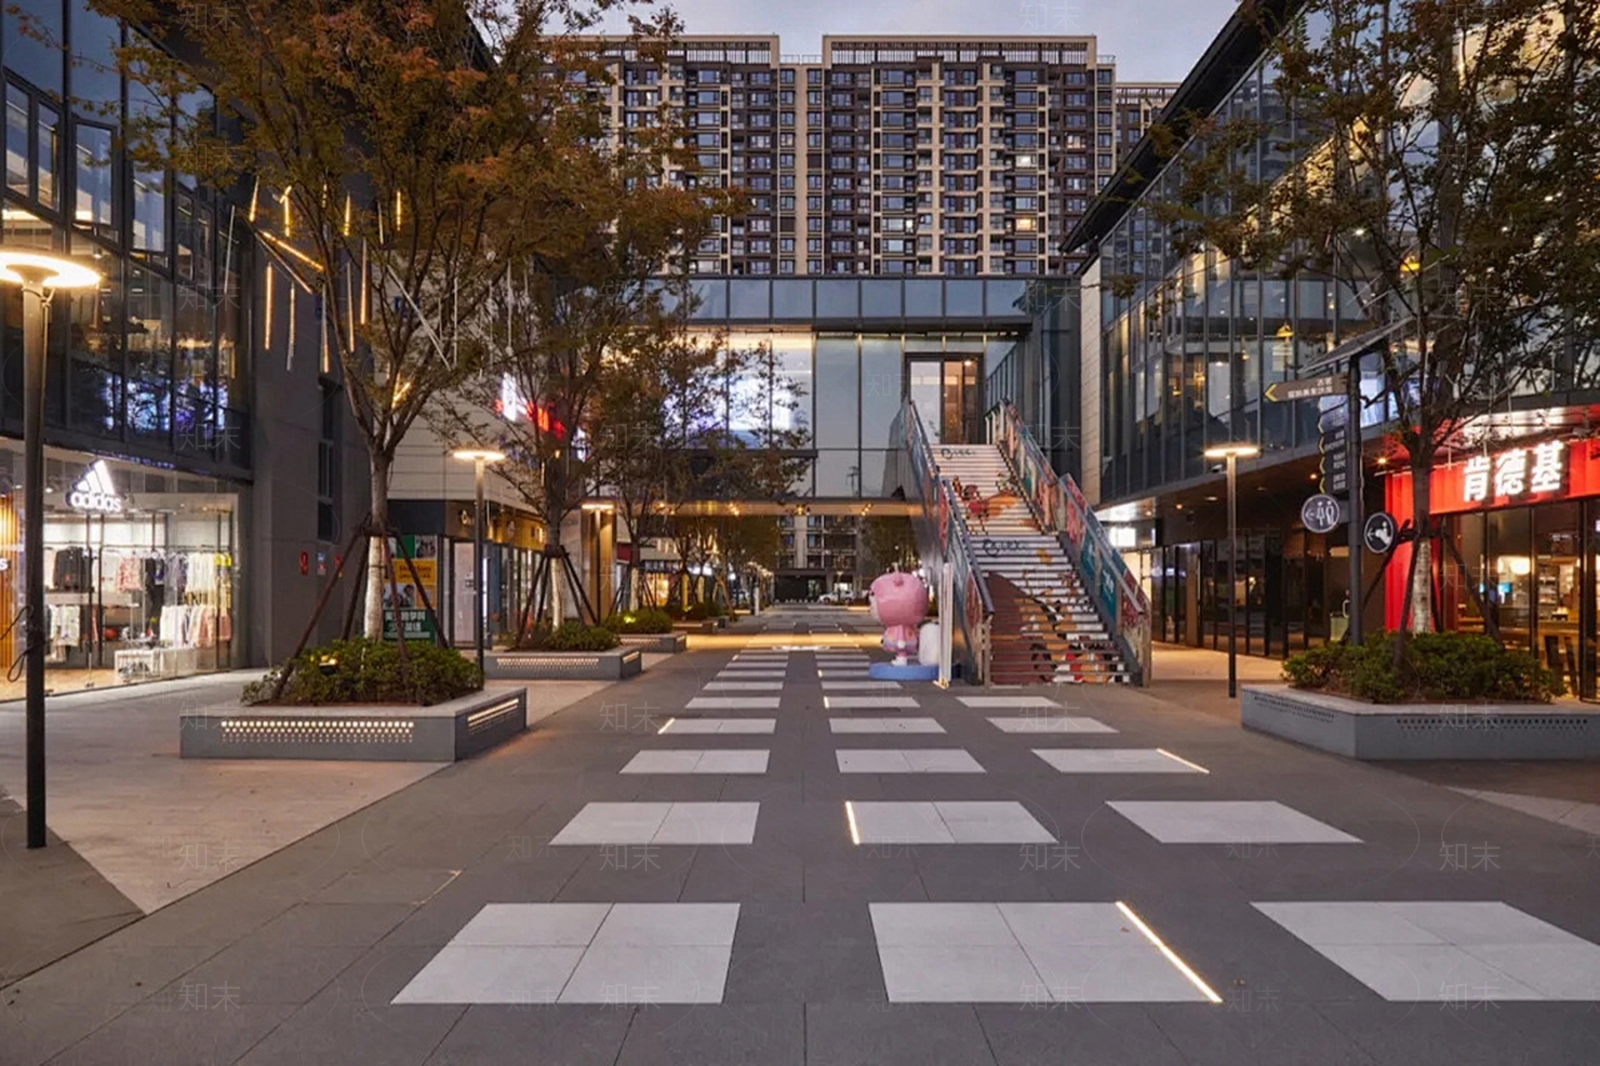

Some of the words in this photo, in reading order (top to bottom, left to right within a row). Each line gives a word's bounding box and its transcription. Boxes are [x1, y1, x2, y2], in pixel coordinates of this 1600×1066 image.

[1463, 439, 1565, 503] 肯德基
[70, 491, 121, 512] adidas
